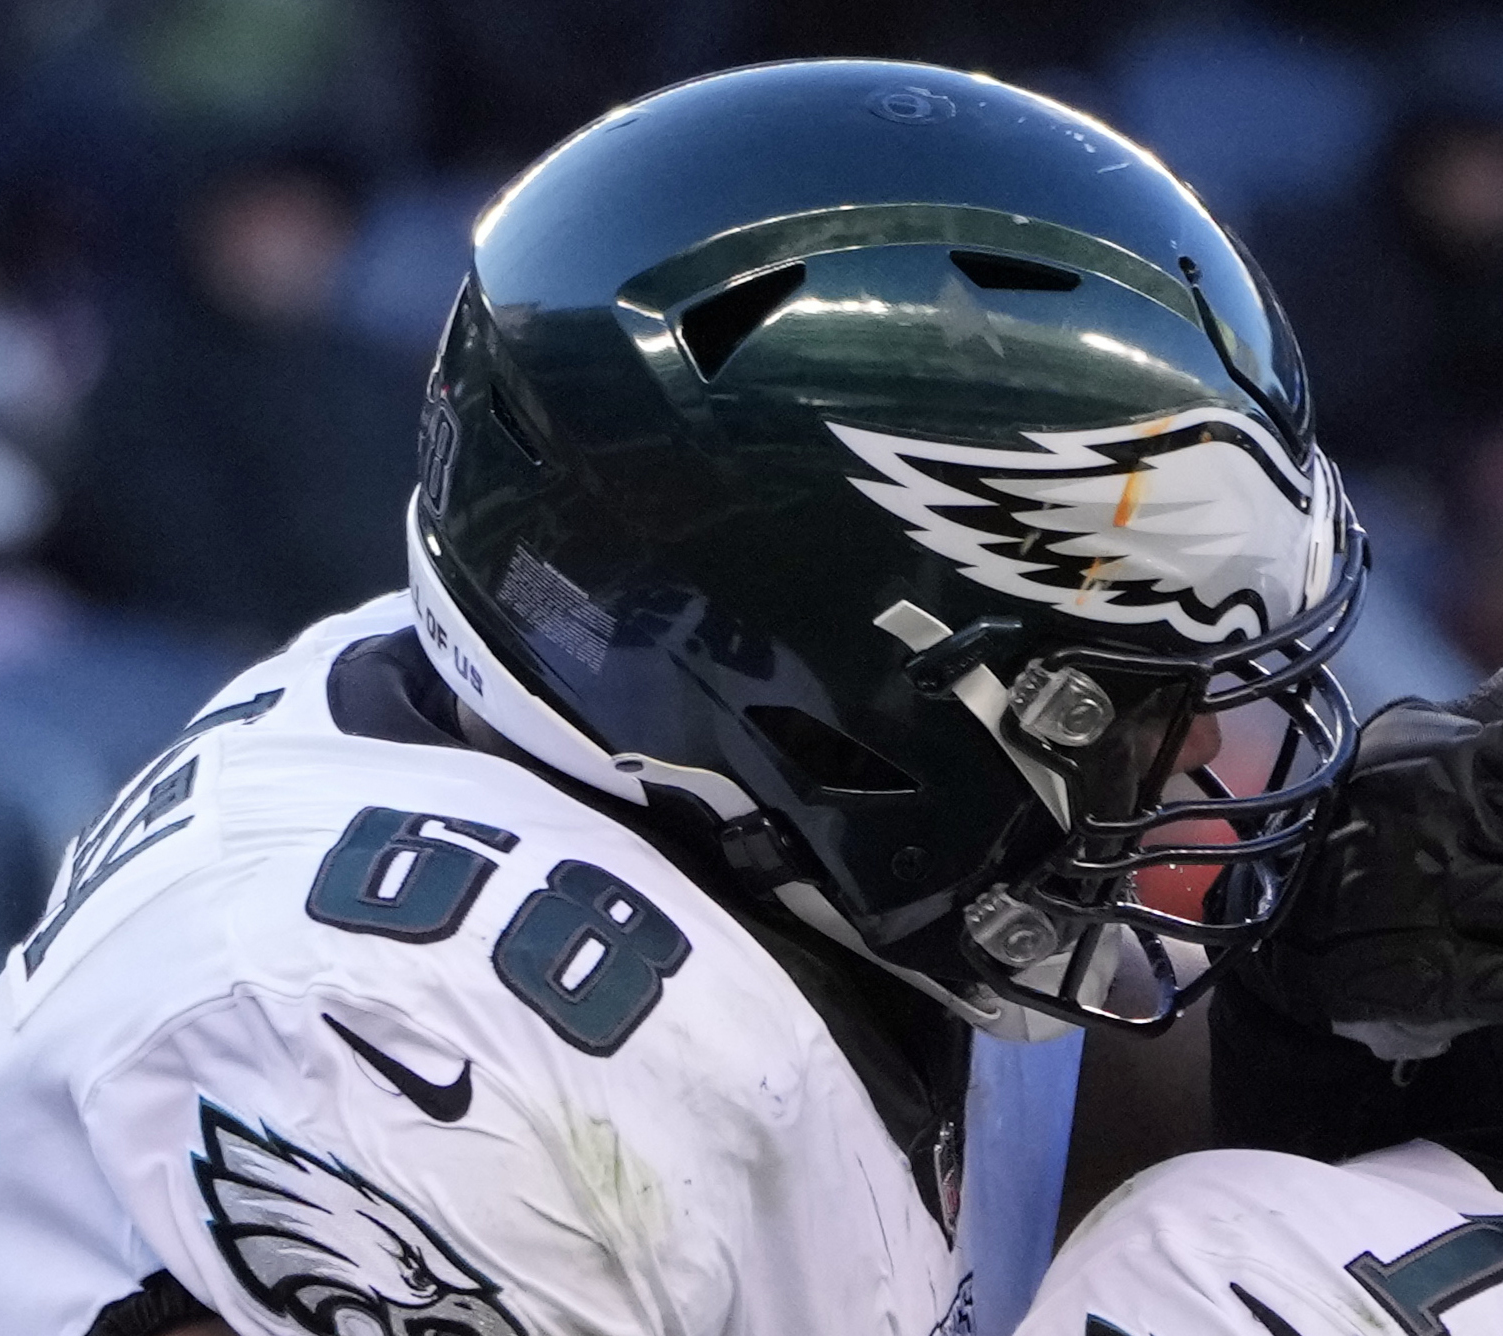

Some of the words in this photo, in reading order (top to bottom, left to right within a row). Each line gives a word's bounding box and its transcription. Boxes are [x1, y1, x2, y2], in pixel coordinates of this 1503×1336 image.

[426, 607, 448, 650] OF
[454, 645, 484, 698] US
[305, 805, 693, 1058] 68
